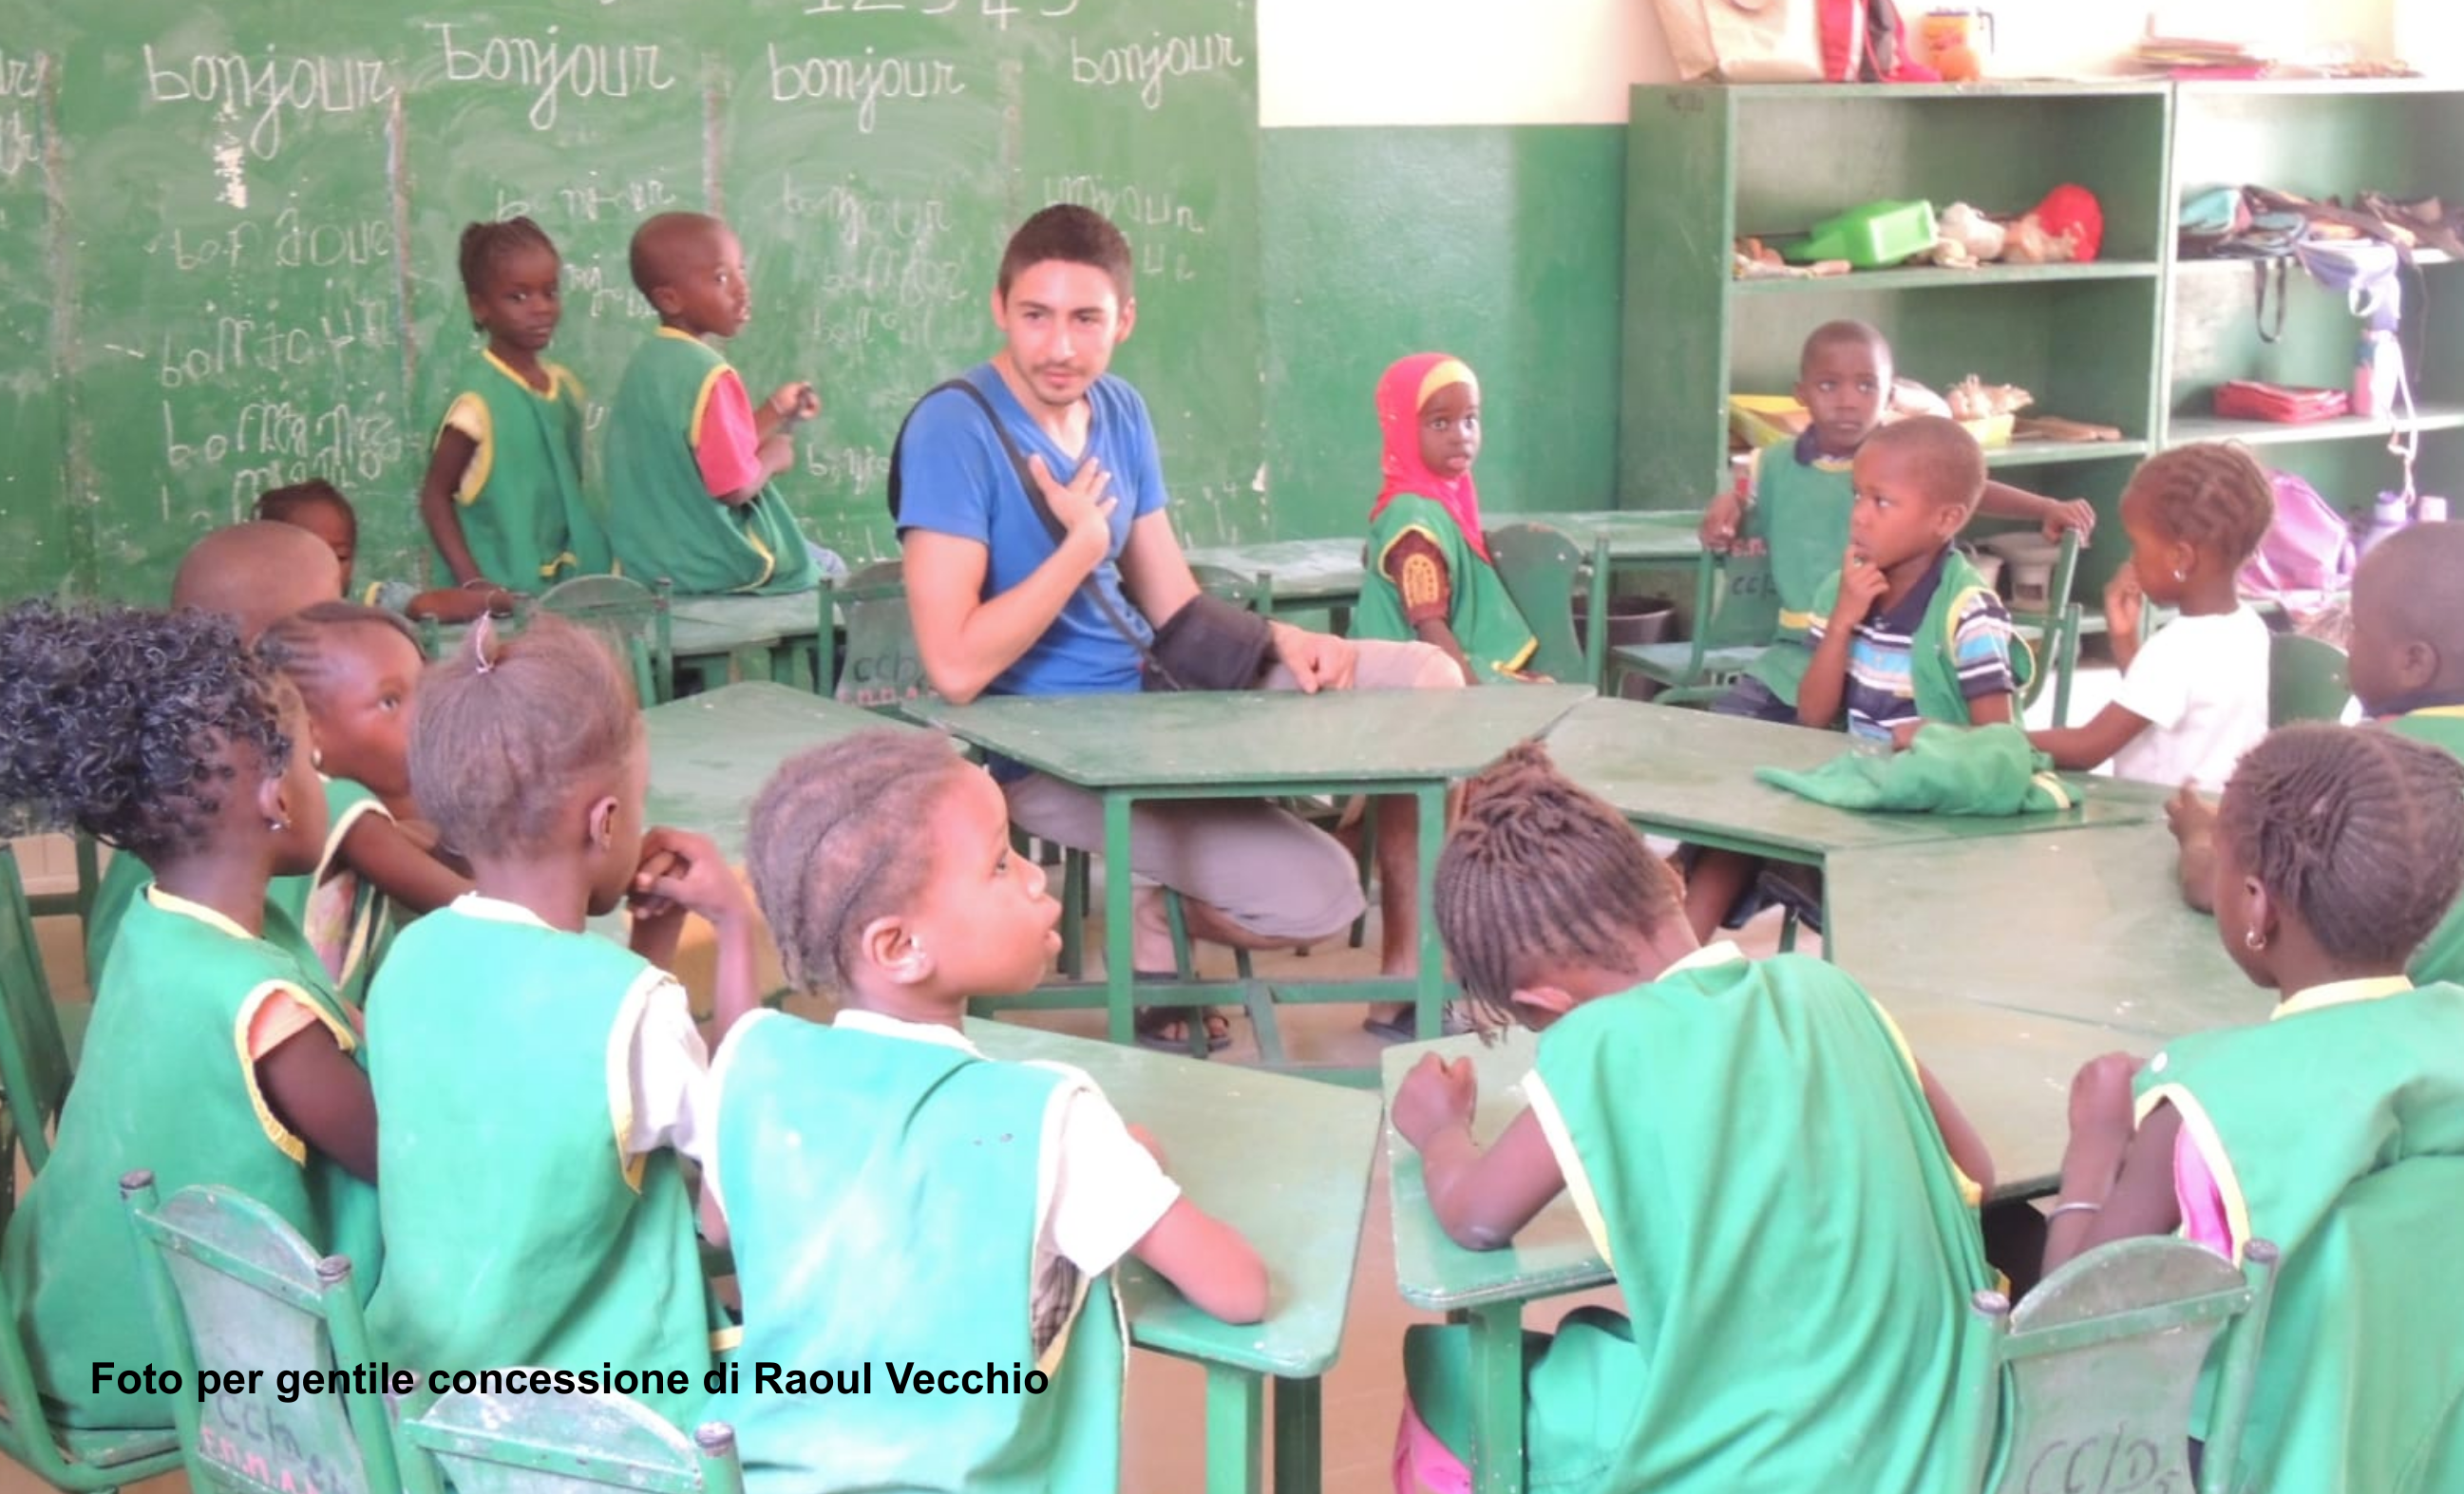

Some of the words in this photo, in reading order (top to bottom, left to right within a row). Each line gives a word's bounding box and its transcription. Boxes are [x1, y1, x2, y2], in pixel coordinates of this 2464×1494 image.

[142, 43, 395, 161] bonjour
[768, 41, 966, 134] bonjour
[1071, 30, 1243, 110] bonjour
